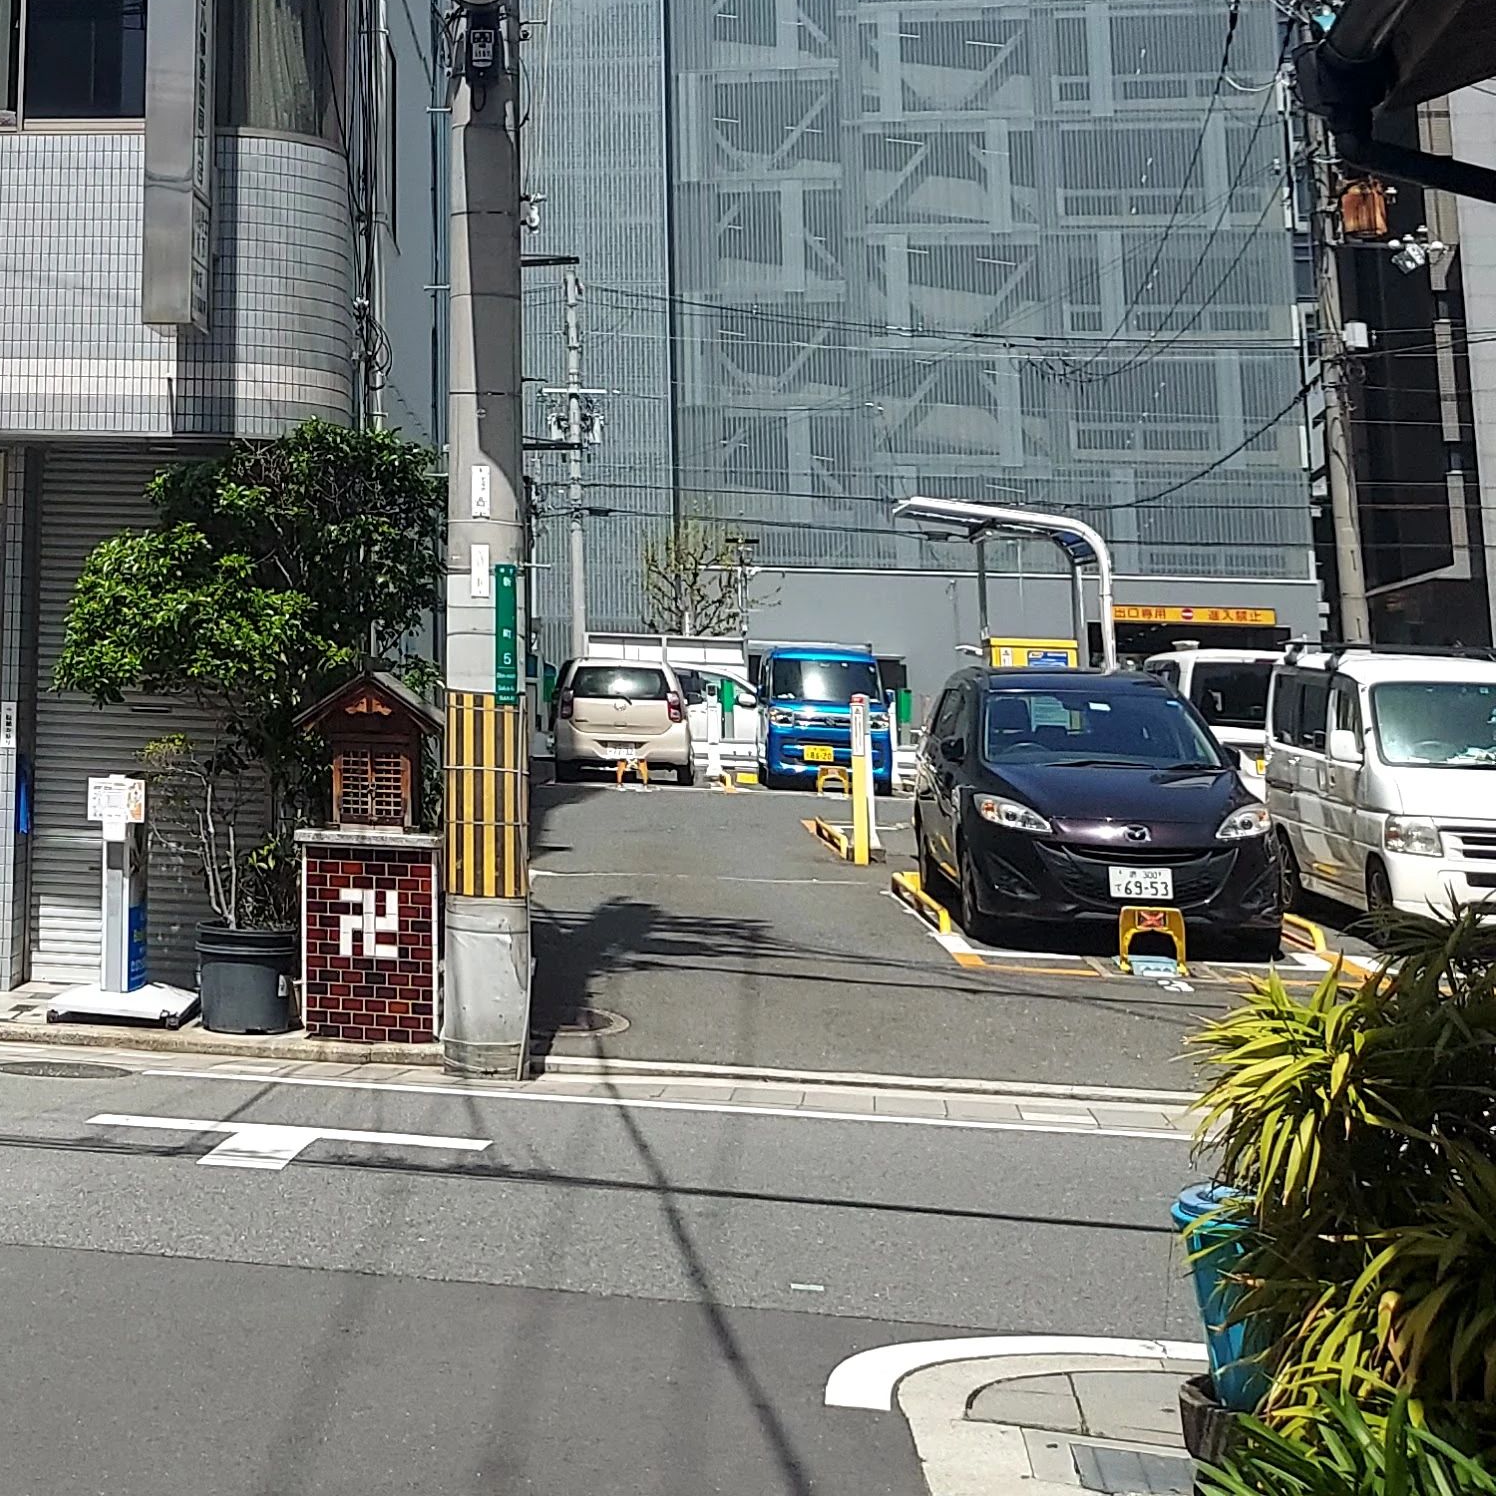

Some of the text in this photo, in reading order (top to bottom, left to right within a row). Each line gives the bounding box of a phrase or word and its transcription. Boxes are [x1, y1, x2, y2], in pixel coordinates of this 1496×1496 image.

[1114, 607, 1264, 622] 出口専用 進入禁止
[1124, 880, 1169, 897] 69-53
